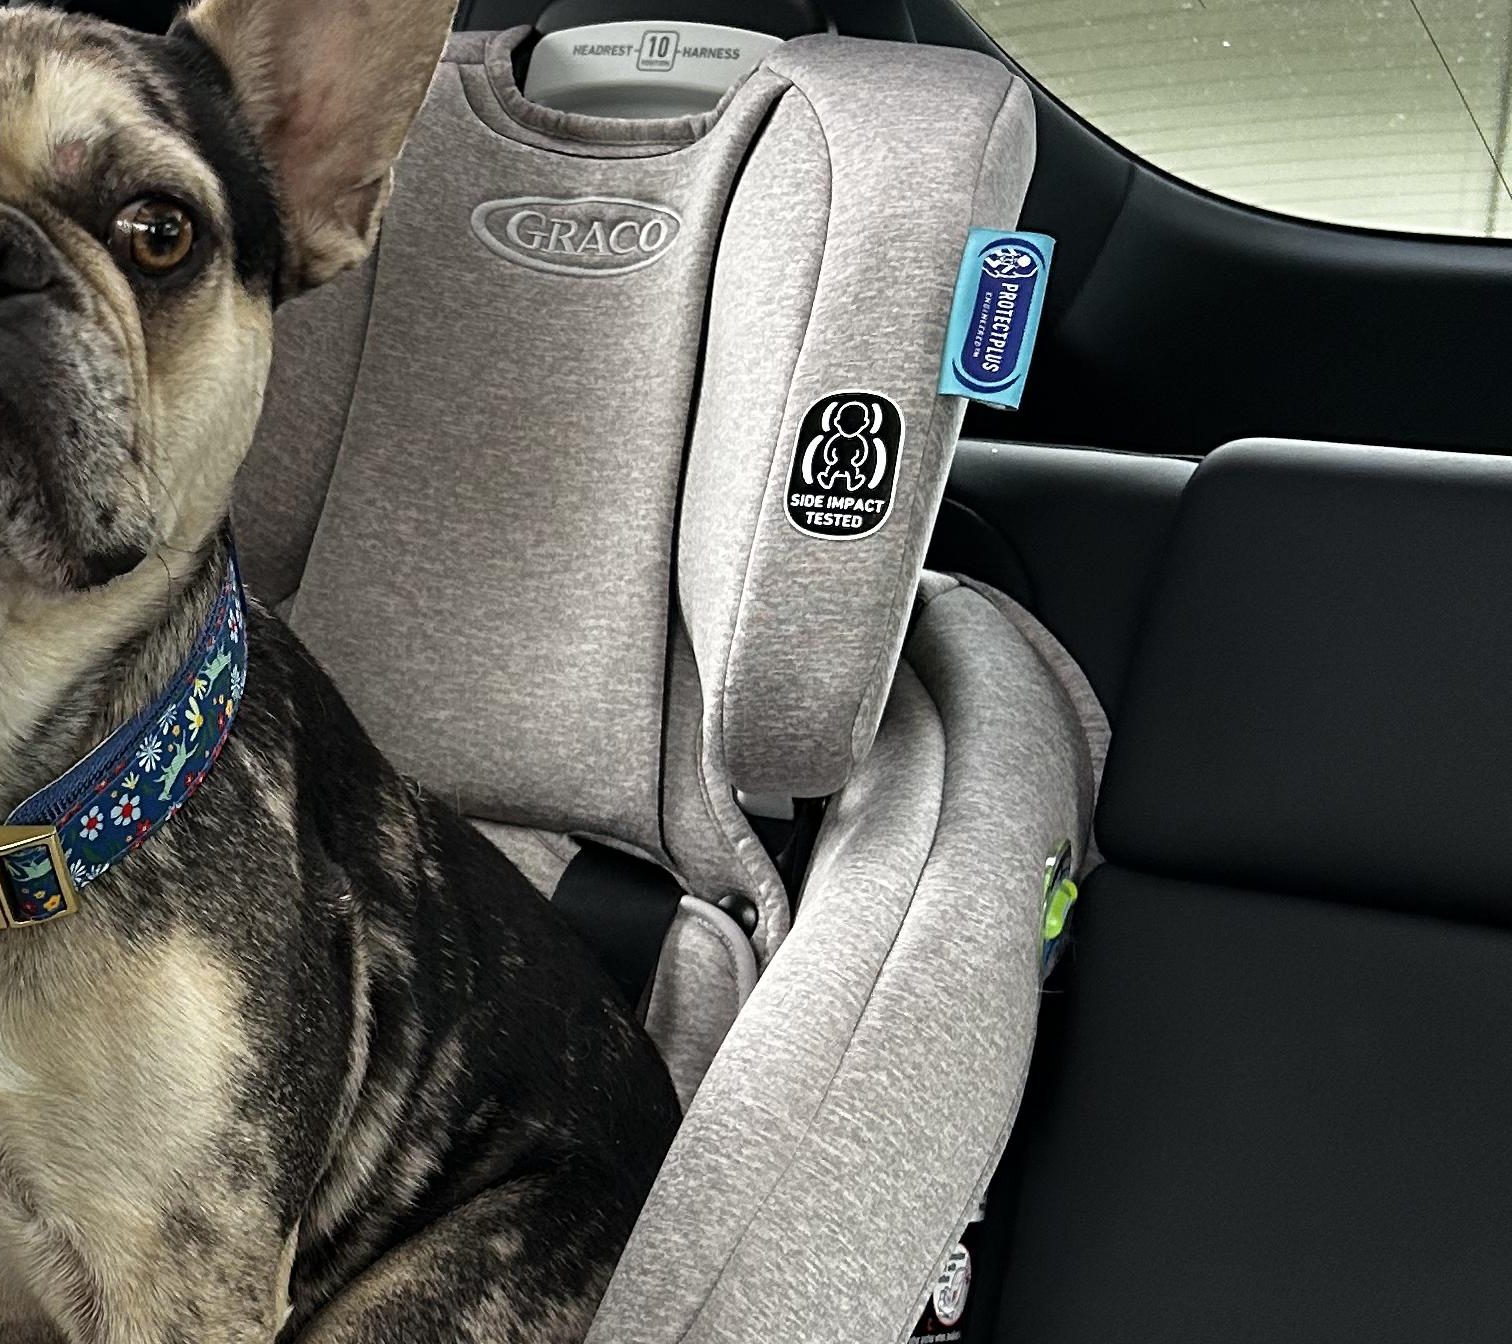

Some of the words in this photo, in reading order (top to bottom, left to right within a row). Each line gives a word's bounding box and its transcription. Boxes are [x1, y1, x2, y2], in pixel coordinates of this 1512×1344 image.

[572, 44, 634, 57] HEADREST
[648, 35, 670, 58] 10
[682, 46, 741, 60] HARNESS
[505, 210, 669, 256] GRACO
[981, 282, 1019, 373] PROTECTPLUS
[789, 493, 826, 508] SIDE
[826, 495, 886, 514] IMPACT
[805, 511, 864, 529] TESTED
